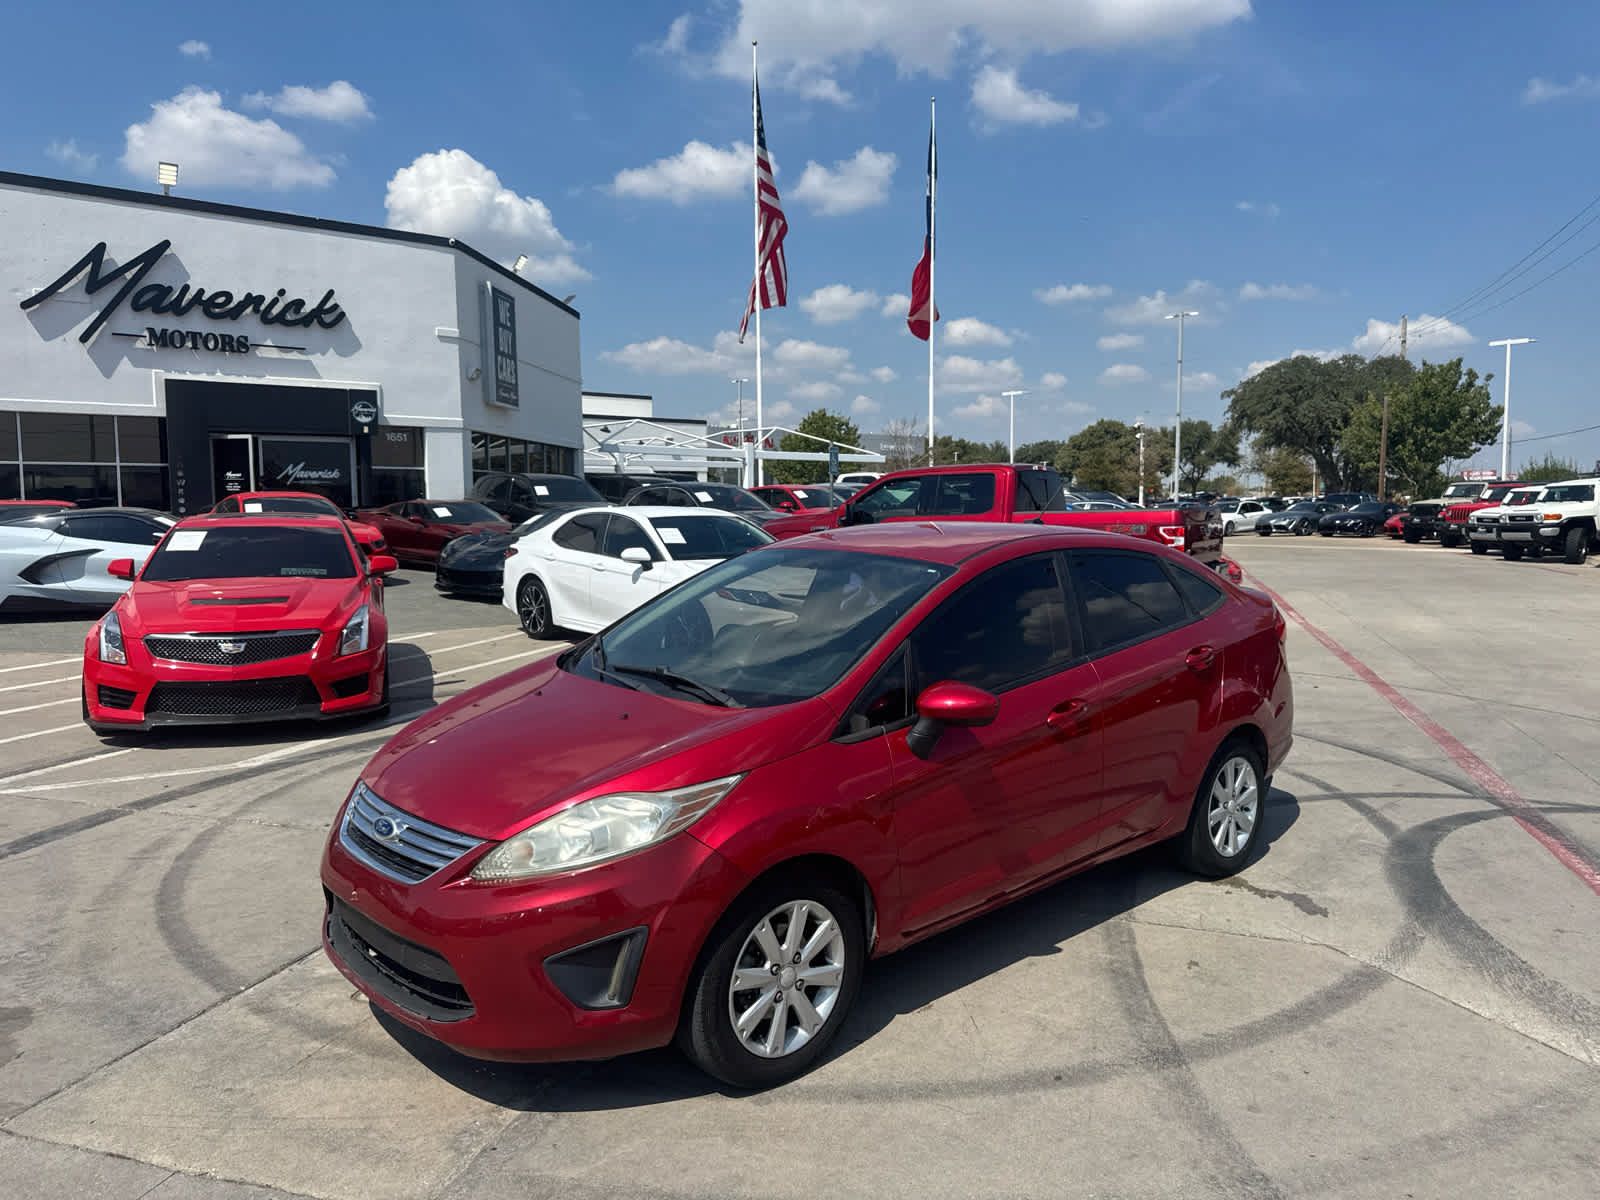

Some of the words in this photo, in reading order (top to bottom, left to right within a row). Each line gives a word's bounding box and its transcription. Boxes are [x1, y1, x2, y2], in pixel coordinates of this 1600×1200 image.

[20, 239, 346, 345] Maverick
[146, 327, 250, 353] MOTORS
[384, 432, 408, 442] 1651
[276, 461, 340, 486] Maverick
